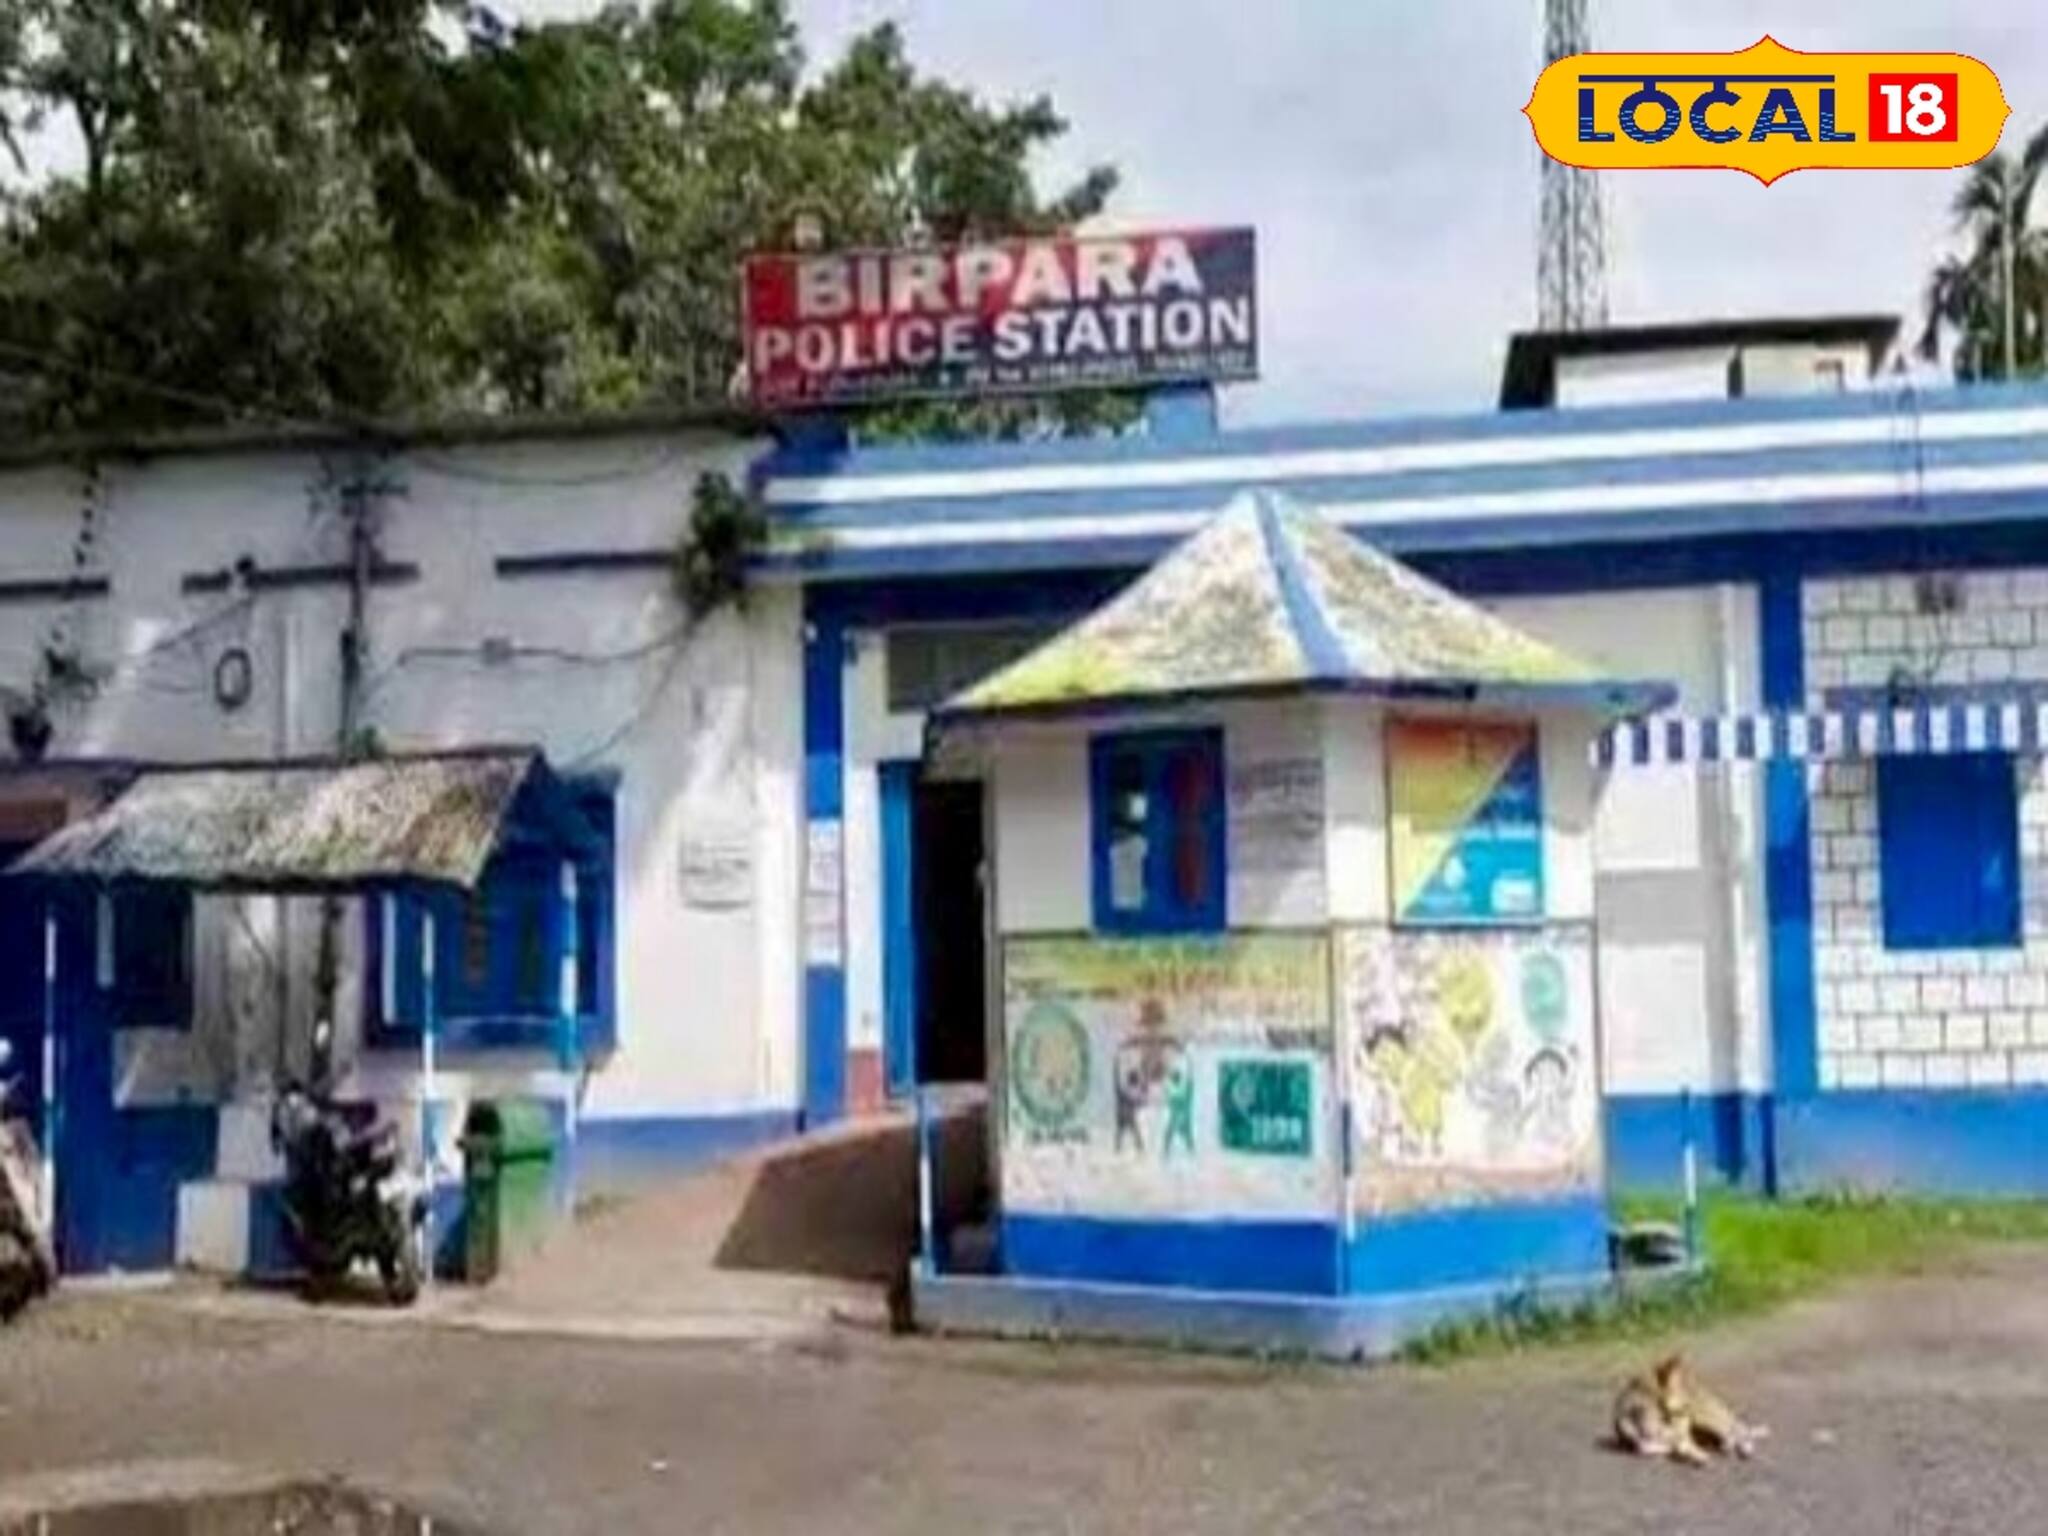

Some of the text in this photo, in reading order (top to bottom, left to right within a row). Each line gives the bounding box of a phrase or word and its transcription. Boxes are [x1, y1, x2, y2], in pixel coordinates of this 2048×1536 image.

[798, 237, 1201, 315] BIRPARA
[755, 296, 1249, 371] POLICE STATION
